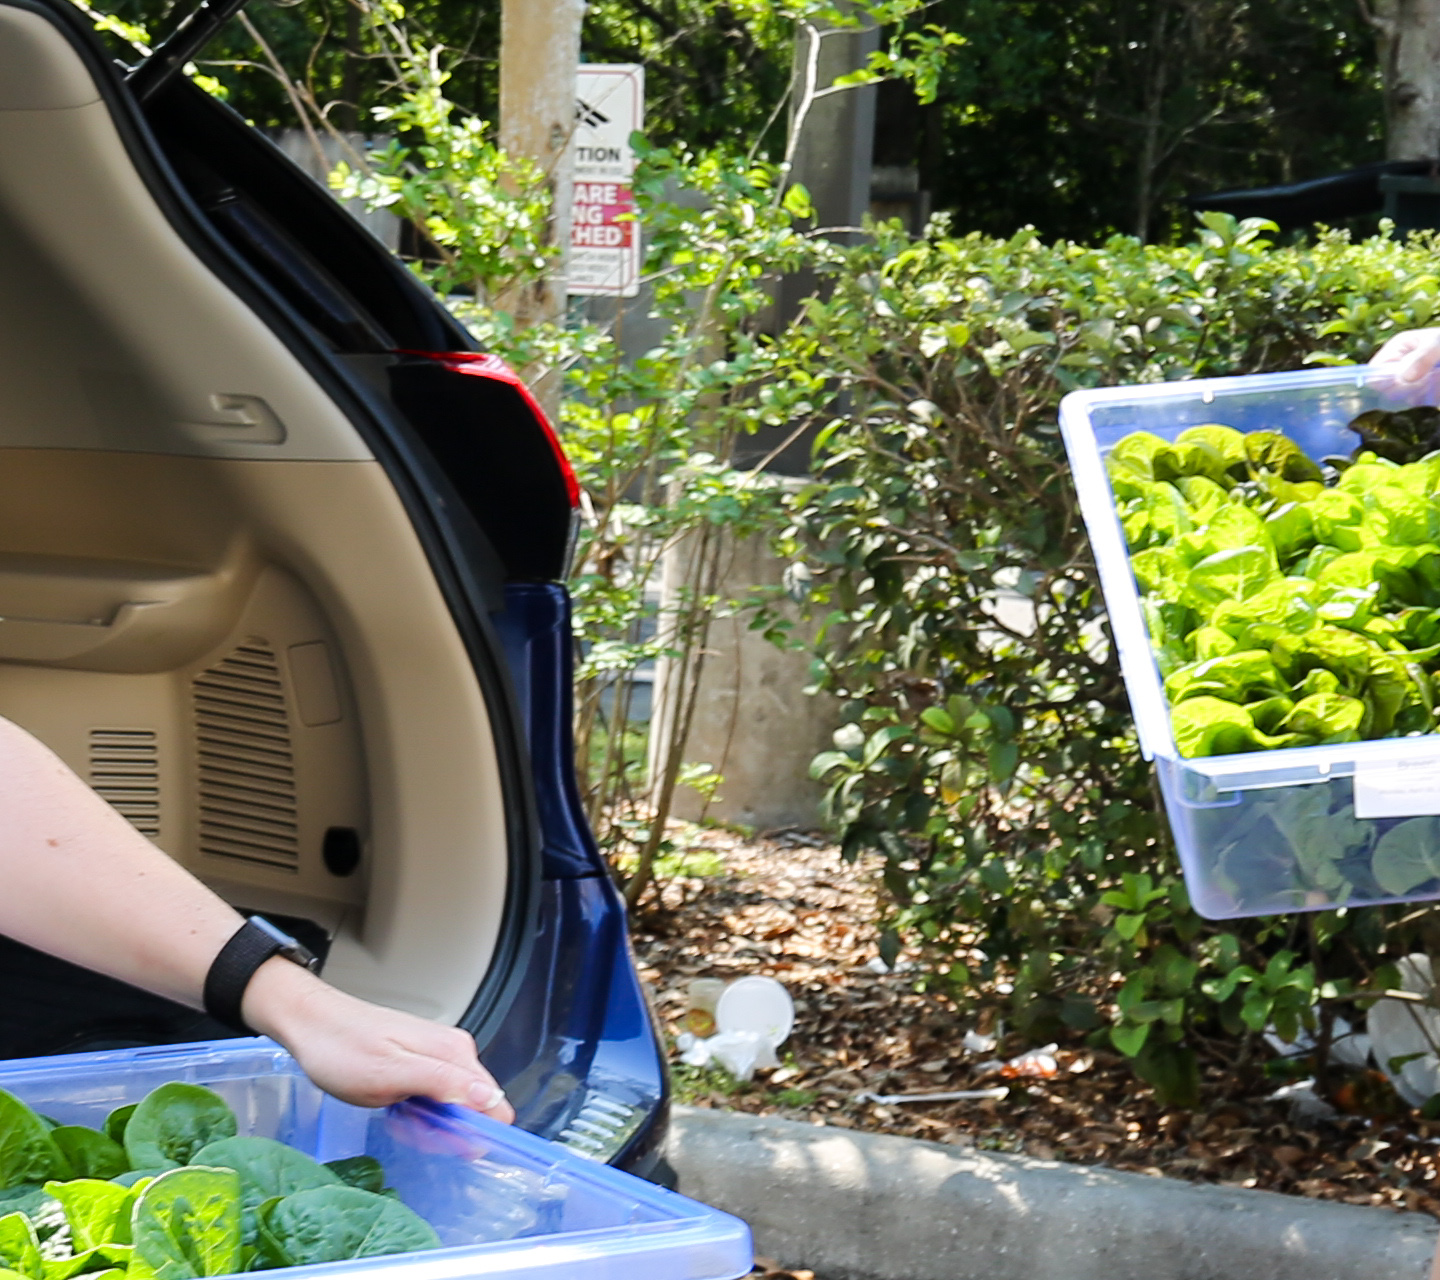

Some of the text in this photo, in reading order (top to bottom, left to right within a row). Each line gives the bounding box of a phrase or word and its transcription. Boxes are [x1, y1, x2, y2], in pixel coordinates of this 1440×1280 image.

[577, 147, 621, 163] TION
[574, 184, 619, 205] ARE
[572, 204, 604, 225] NG
